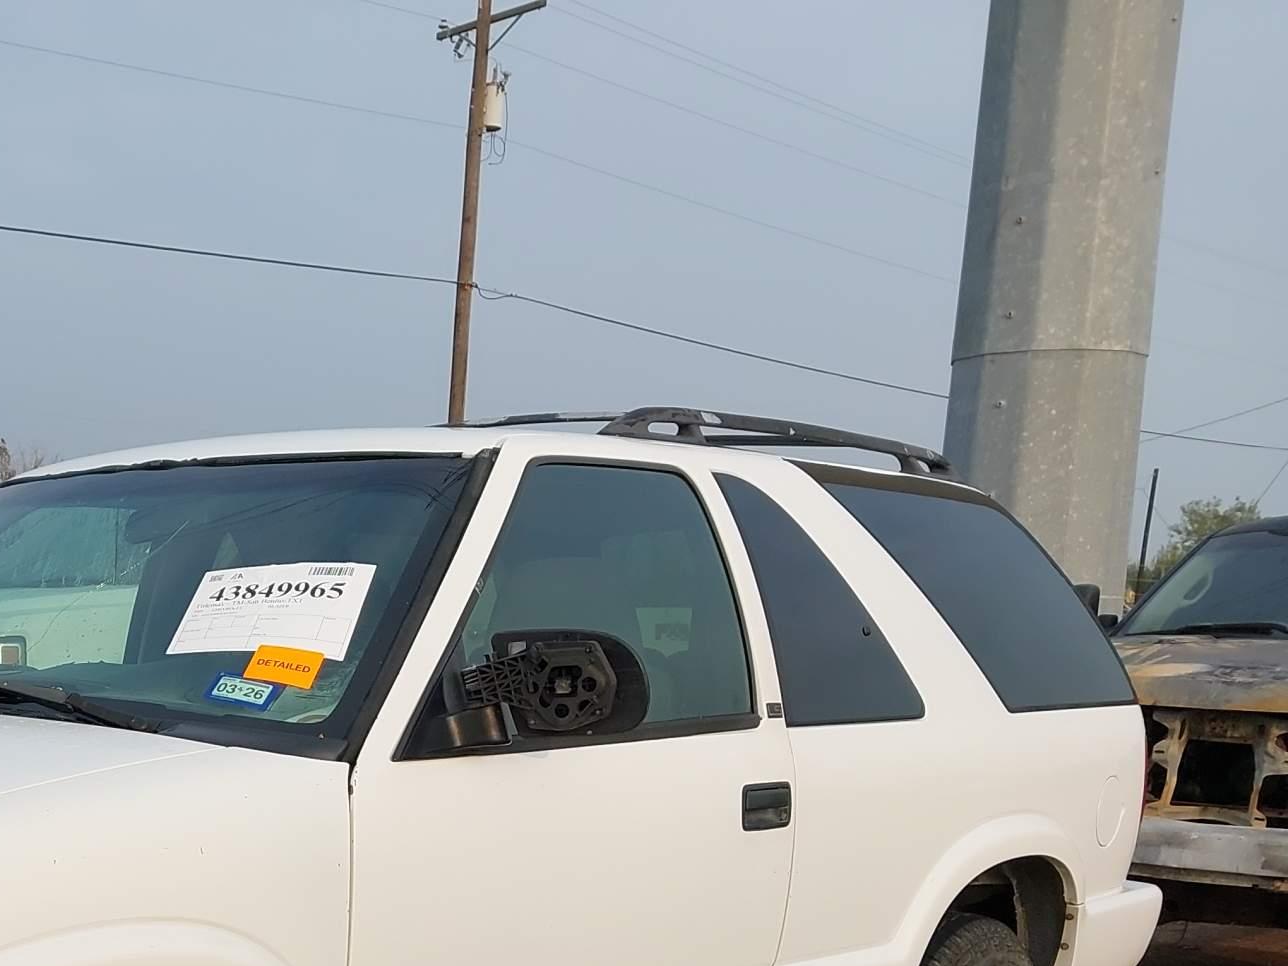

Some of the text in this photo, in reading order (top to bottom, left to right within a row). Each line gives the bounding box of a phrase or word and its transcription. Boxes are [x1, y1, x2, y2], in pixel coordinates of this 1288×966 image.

[208, 581, 347, 601] 43849965
[256, 658, 311, 674] DETAILED
[216, 683, 266, 700] 03 26
